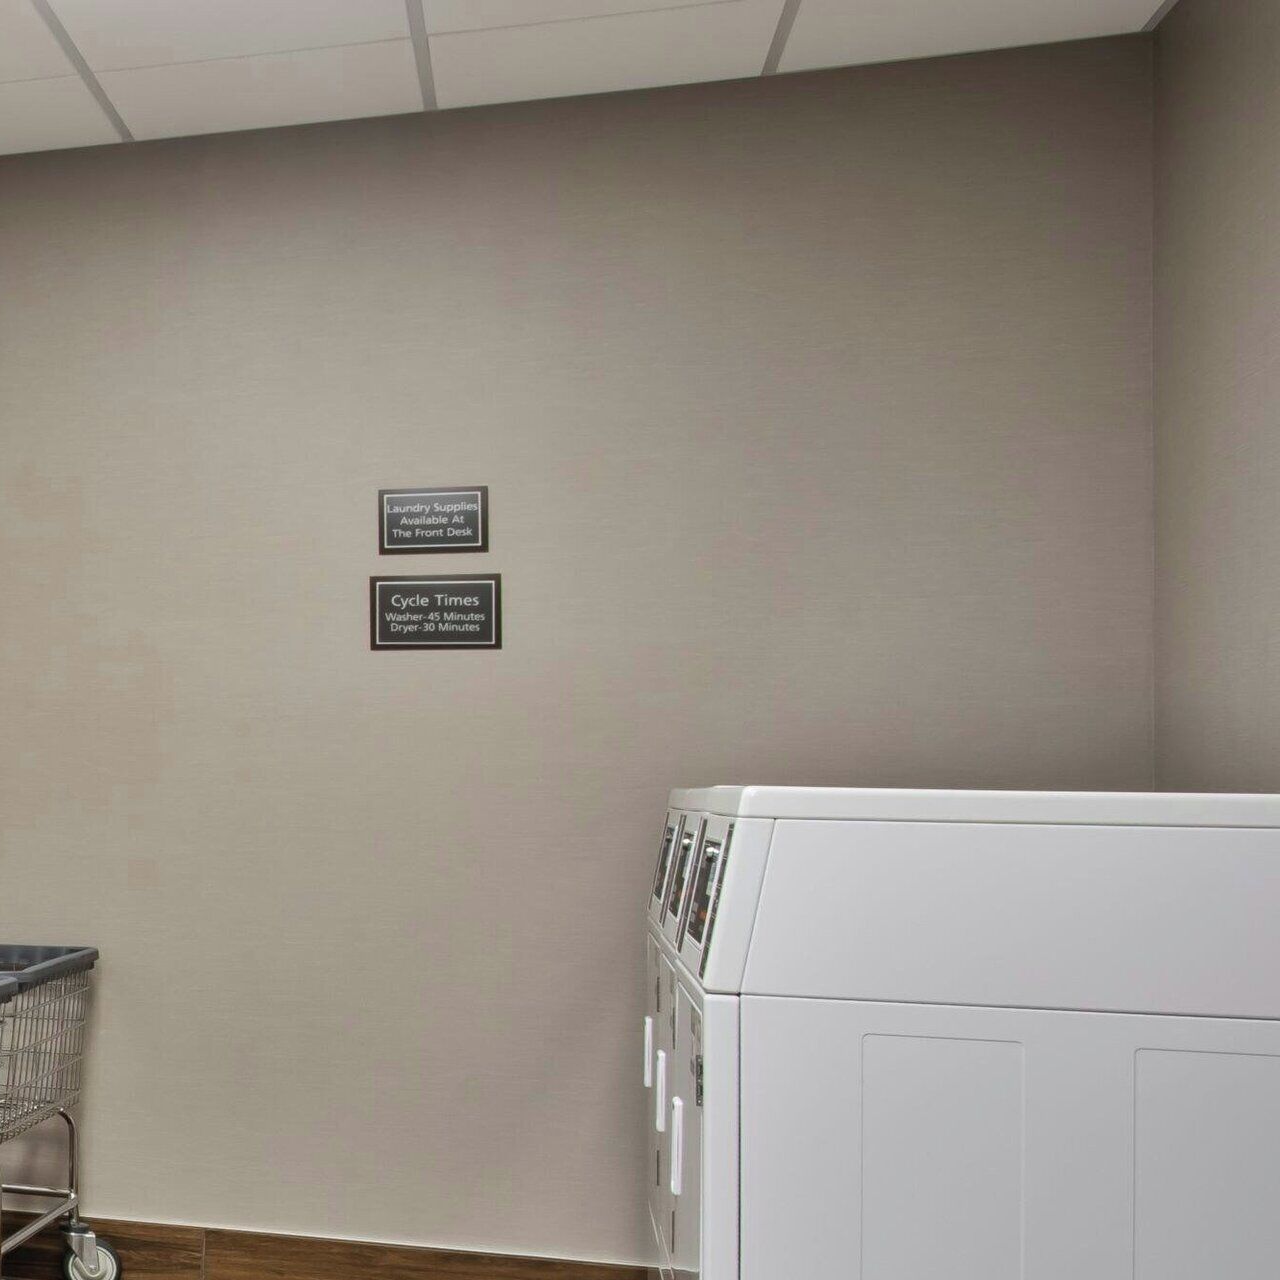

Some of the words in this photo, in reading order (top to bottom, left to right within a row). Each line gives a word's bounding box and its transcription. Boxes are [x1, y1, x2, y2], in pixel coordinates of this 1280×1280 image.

[387, 503, 431, 514] Laundry
[433, 501, 478, 513] Supplies
[400, 515, 448, 526] Available
[452, 514, 465, 524] At
[392, 529, 412, 538] The
[415, 528, 444, 537] Front
[447, 527, 473, 537] Desk
[391, 594, 429, 610] Cycle
[434, 594, 480, 606] Times
[443, 612, 485, 621] Minutes
[438, 623, 480, 632] Minutes
